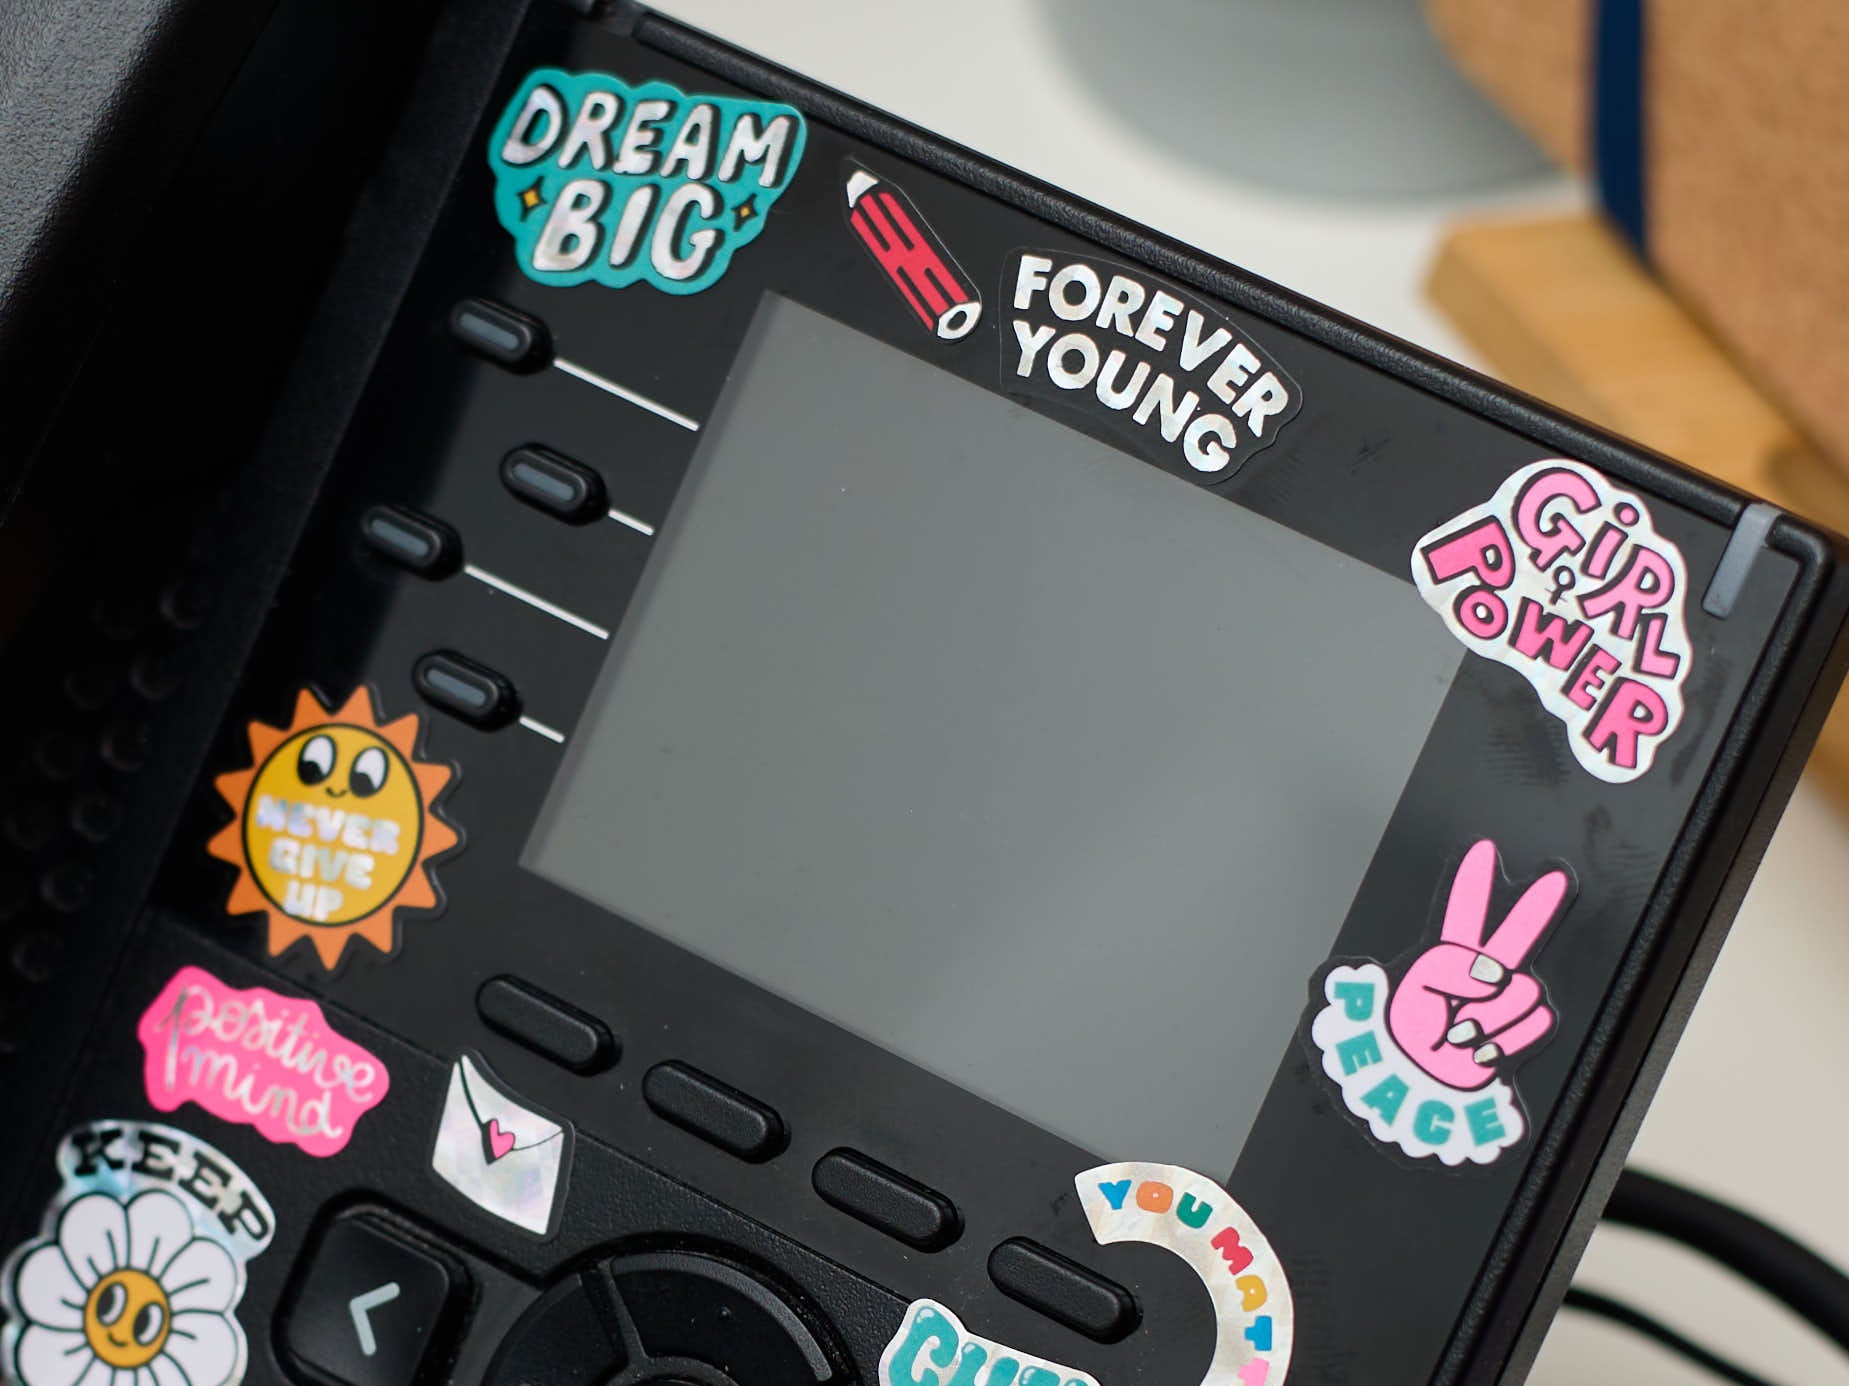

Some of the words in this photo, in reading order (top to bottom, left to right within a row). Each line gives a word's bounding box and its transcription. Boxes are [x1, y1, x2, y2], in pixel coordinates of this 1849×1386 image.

[501, 84, 797, 187] DREAM
[531, 178, 725, 282] BIG
[1012, 319, 1237, 473] YOUNG
[1013, 254, 1289, 438] FOREVER
[1420, 514, 1669, 769] POWER
[256, 795, 400, 856] NEVER
[268, 837, 376, 890] GIVE
[282, 880, 344, 922] UP
[153, 984, 376, 1103] positive
[181, 1046, 343, 1139] mind
[1333, 981, 1507, 1147] PEACE
[70, 1127, 270, 1241] KEEP
[1097, 1179, 1213, 1229] YOU
